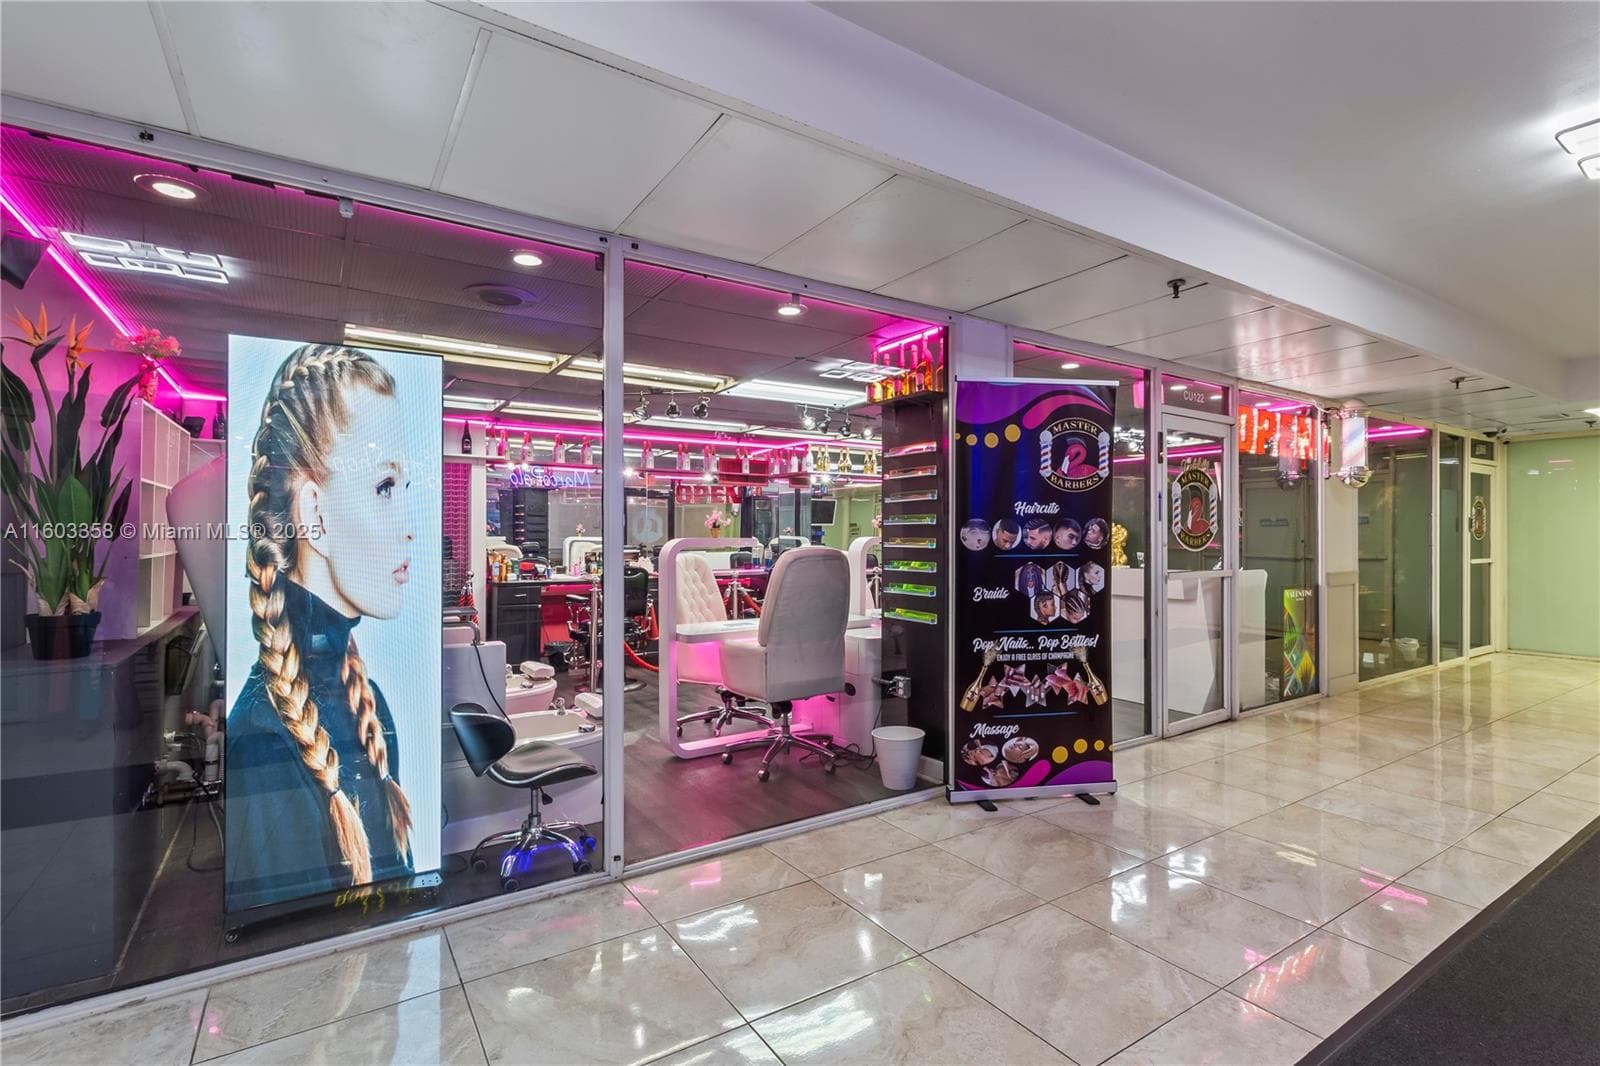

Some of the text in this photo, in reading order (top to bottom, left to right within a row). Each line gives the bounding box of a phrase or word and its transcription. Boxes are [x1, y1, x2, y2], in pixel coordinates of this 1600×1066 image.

[1183, 390, 1205, 403] CU122
[1053, 420, 1098, 435] MASTER
[1051, 474, 1100, 489] BARBERS
[1180, 472, 1209, 486] MASTER
[1014, 500, 1060, 516] Haircuts
[972, 586, 1010, 602] Braids
[972, 637, 994, 653] Pop
[1037, 635, 1060, 651] Pop
[1060, 633, 1099, 649] Bottles!
[996, 653, 1011, 661] ENJOY
[1011, 653, 1016, 661] A
[1016, 653, 1026, 661] FREE
[1041, 652, 1048, 660] OF
[1048, 651, 1074, 660] CHAMPAGNE
[969, 723, 1020, 739] Massage
